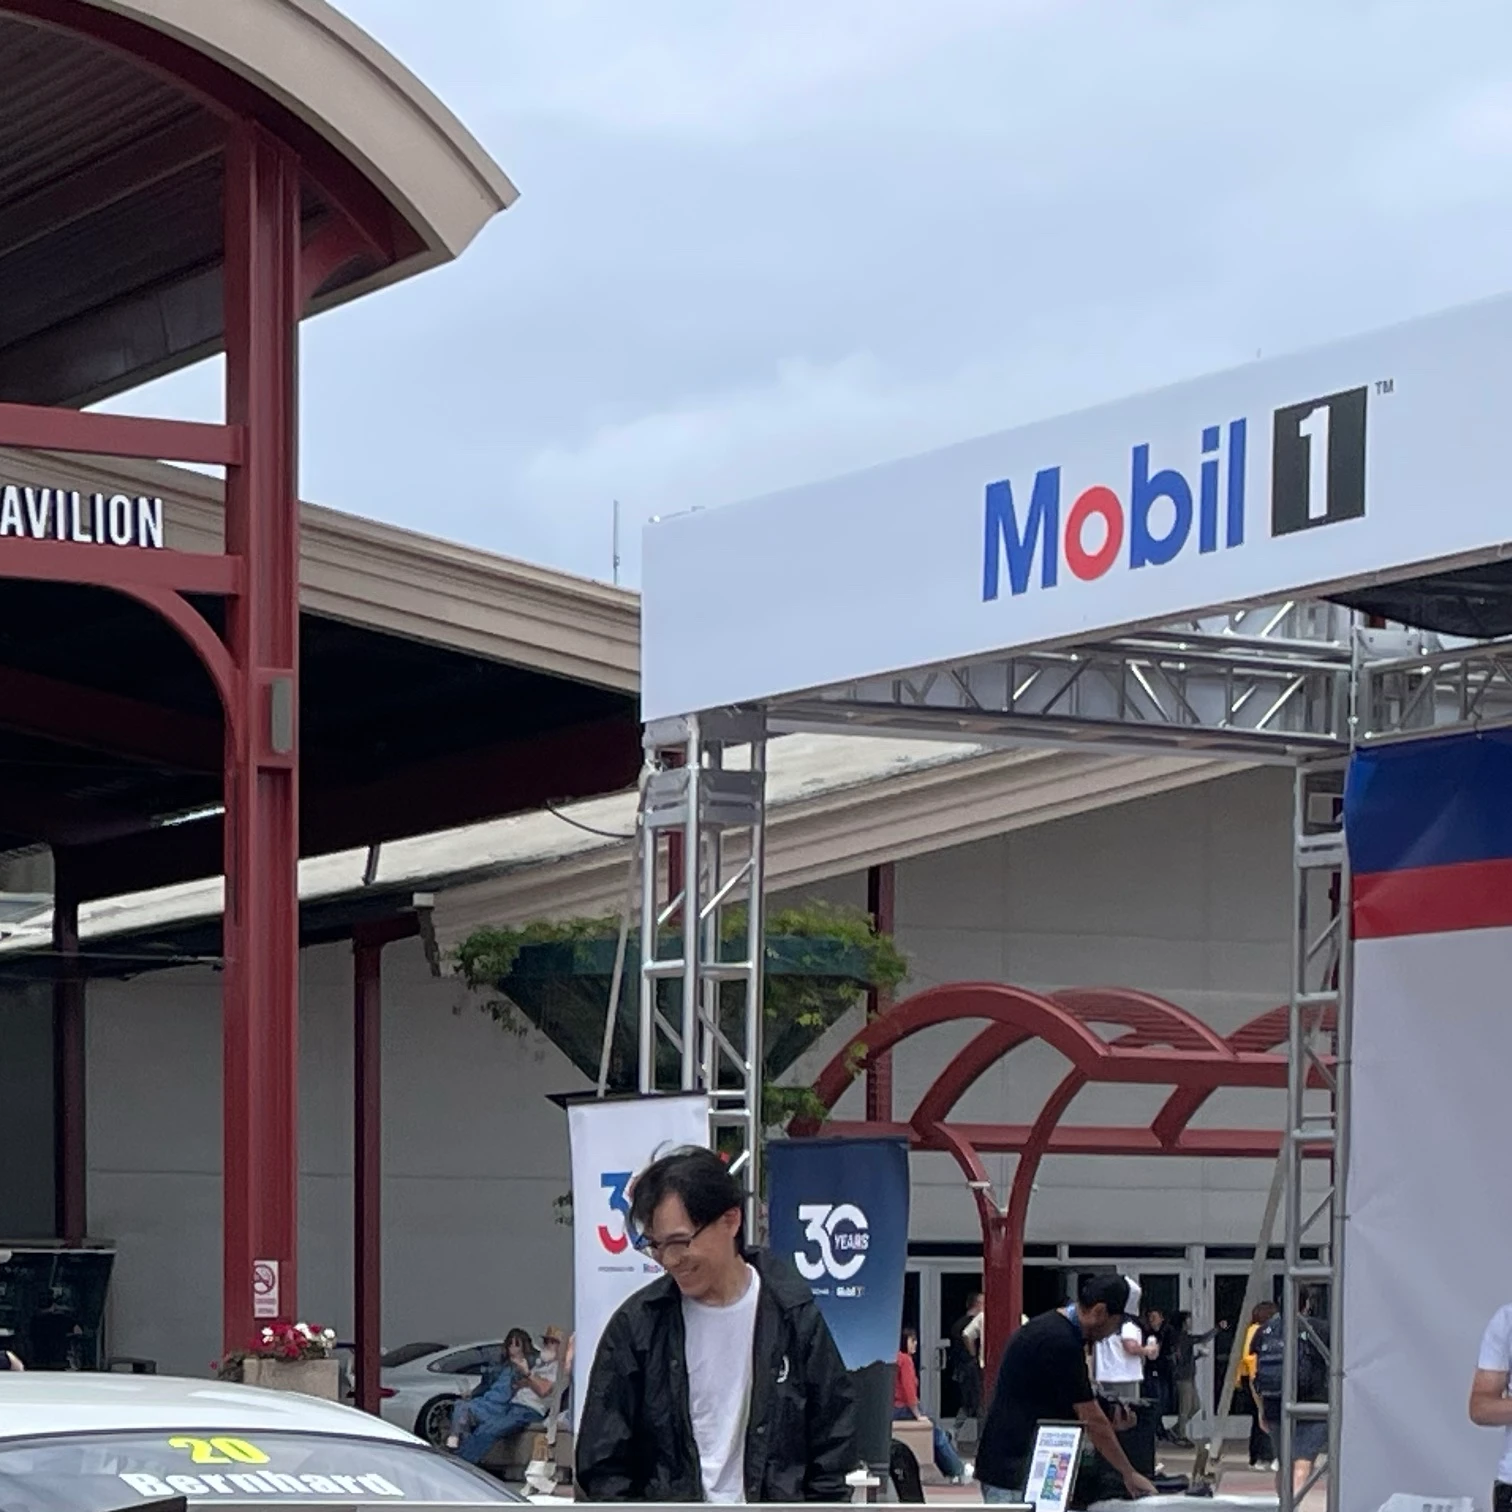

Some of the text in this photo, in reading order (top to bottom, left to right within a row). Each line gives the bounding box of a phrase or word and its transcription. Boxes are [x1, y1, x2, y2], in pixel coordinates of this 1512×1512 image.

[982, 417, 1247, 602] Mobil
[1298, 404, 1332, 520] 1
[834, 1233, 870, 1251] YEARS
[168, 1435, 271, 1465] 20
[119, 1470, 406, 1498] Bernhard
